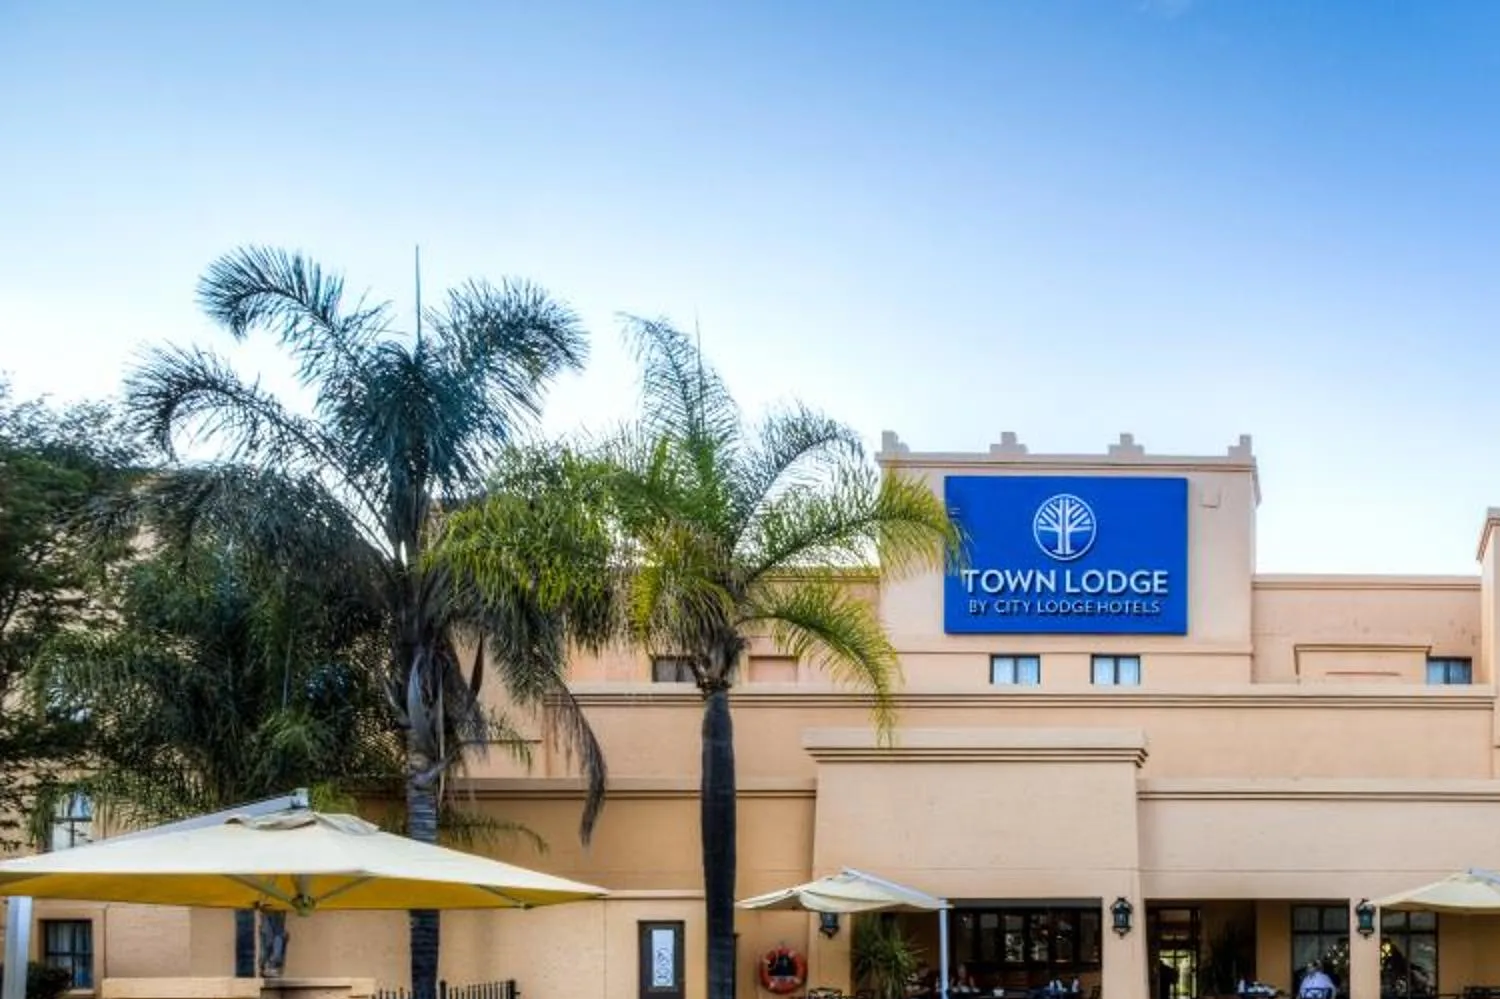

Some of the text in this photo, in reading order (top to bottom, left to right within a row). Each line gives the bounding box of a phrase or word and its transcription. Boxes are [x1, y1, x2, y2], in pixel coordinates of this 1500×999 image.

[963, 569, 1169, 594] TOWN LODGE
[969, 599, 1160, 614] BY CITY LODGE HOTELS
